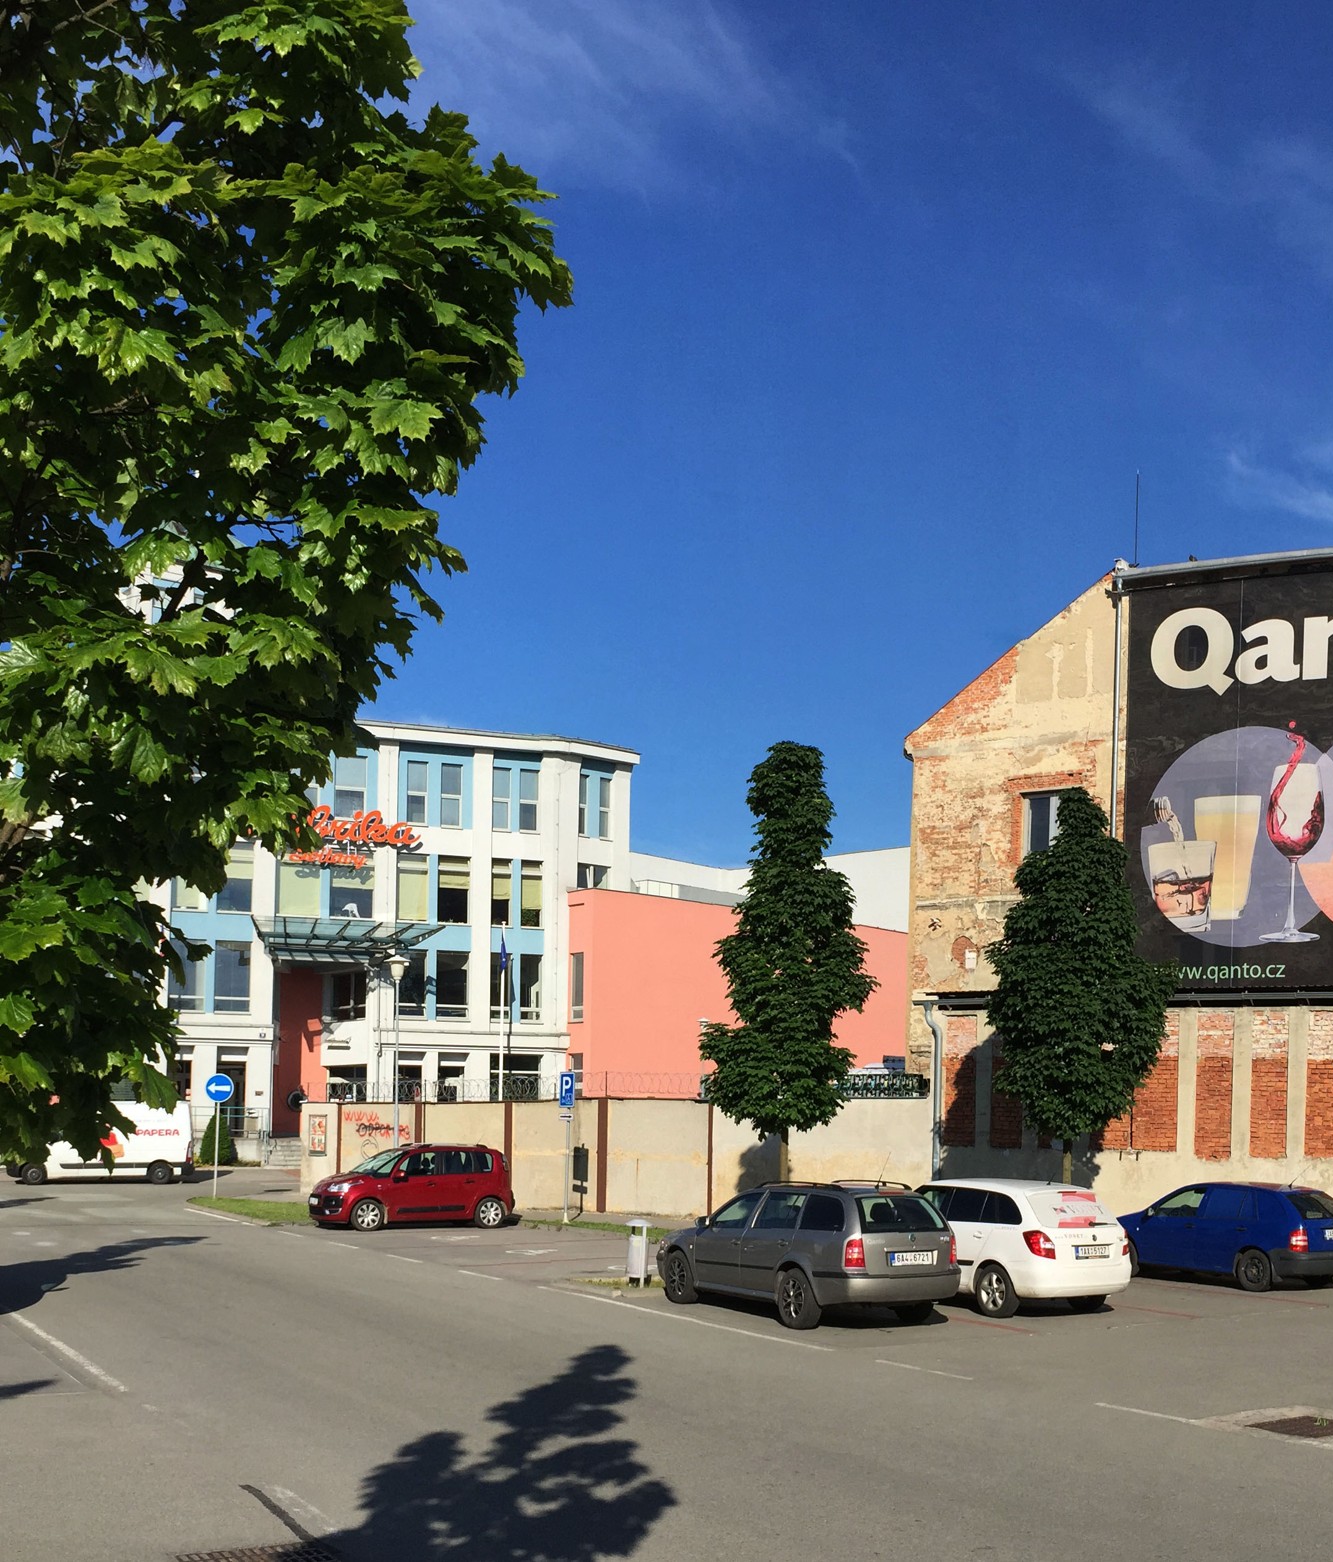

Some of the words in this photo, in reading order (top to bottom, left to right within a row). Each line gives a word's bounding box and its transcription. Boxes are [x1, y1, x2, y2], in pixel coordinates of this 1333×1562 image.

[294, 804, 421, 845] brika
[1154, 963, 1286, 983] ww.qanto.cz
[563, 1076, 571, 1097] P
[913, 1253, 929, 1262] 6721
